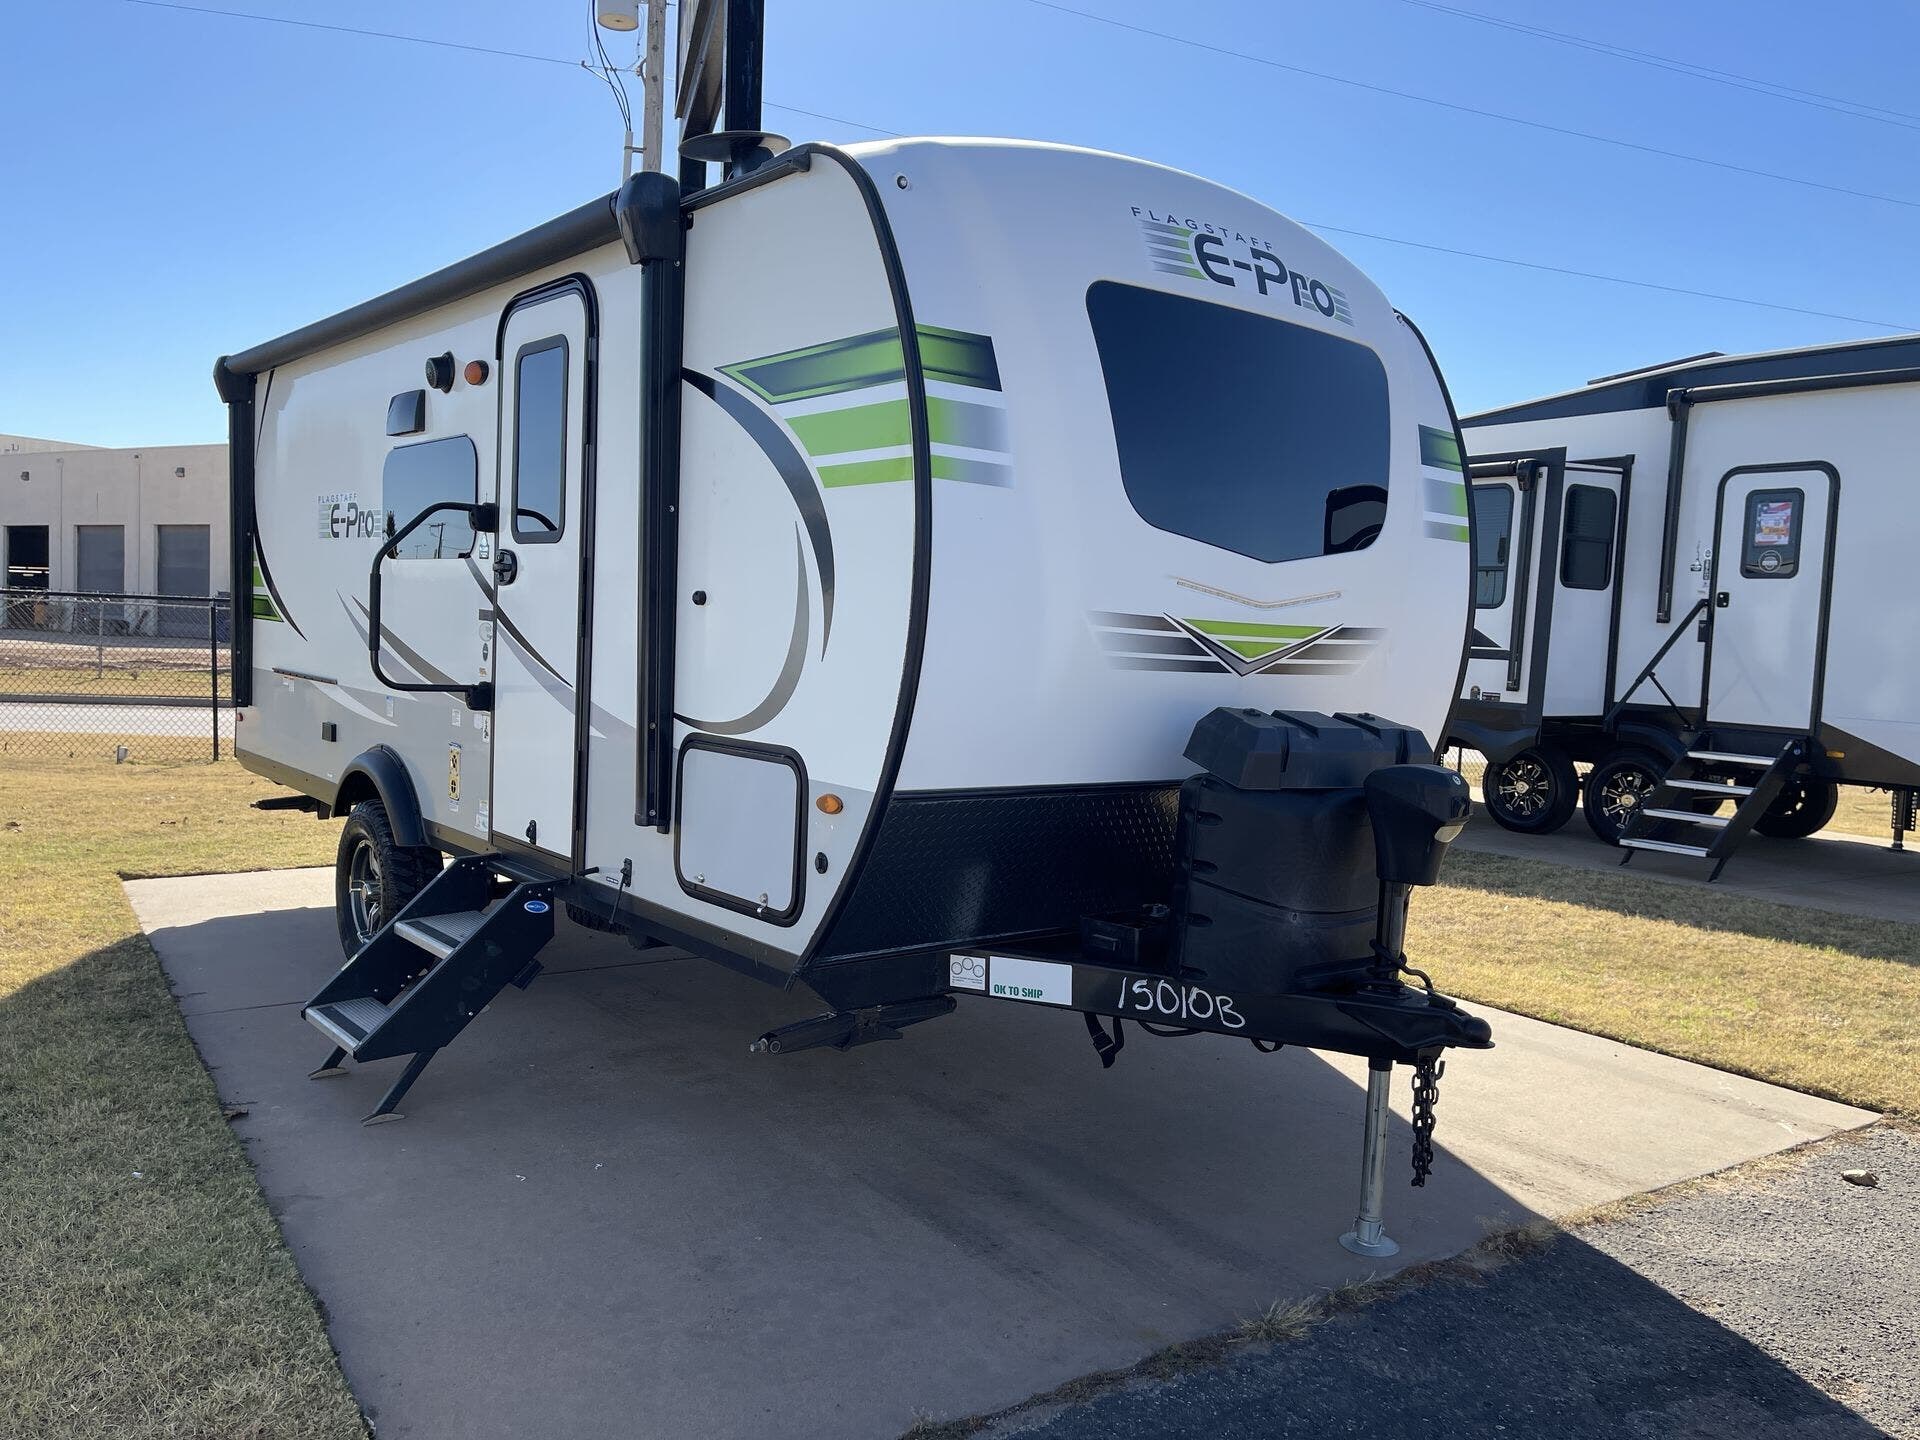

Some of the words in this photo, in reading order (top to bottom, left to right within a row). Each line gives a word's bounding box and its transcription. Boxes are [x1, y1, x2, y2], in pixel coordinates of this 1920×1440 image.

[1130, 206, 1274, 252] FLAGSTAFF
[1194, 232, 1336, 318] E-Pro
[317, 492, 358, 504] FLAGSTAFF
[330, 502, 375, 539] E-Pro
[993, 983, 1007, 995] OK
[1008, 986, 1020, 997] TO
[1021, 987, 1043, 999] SHIP
[1117, 976, 1247, 1029] 15010B
